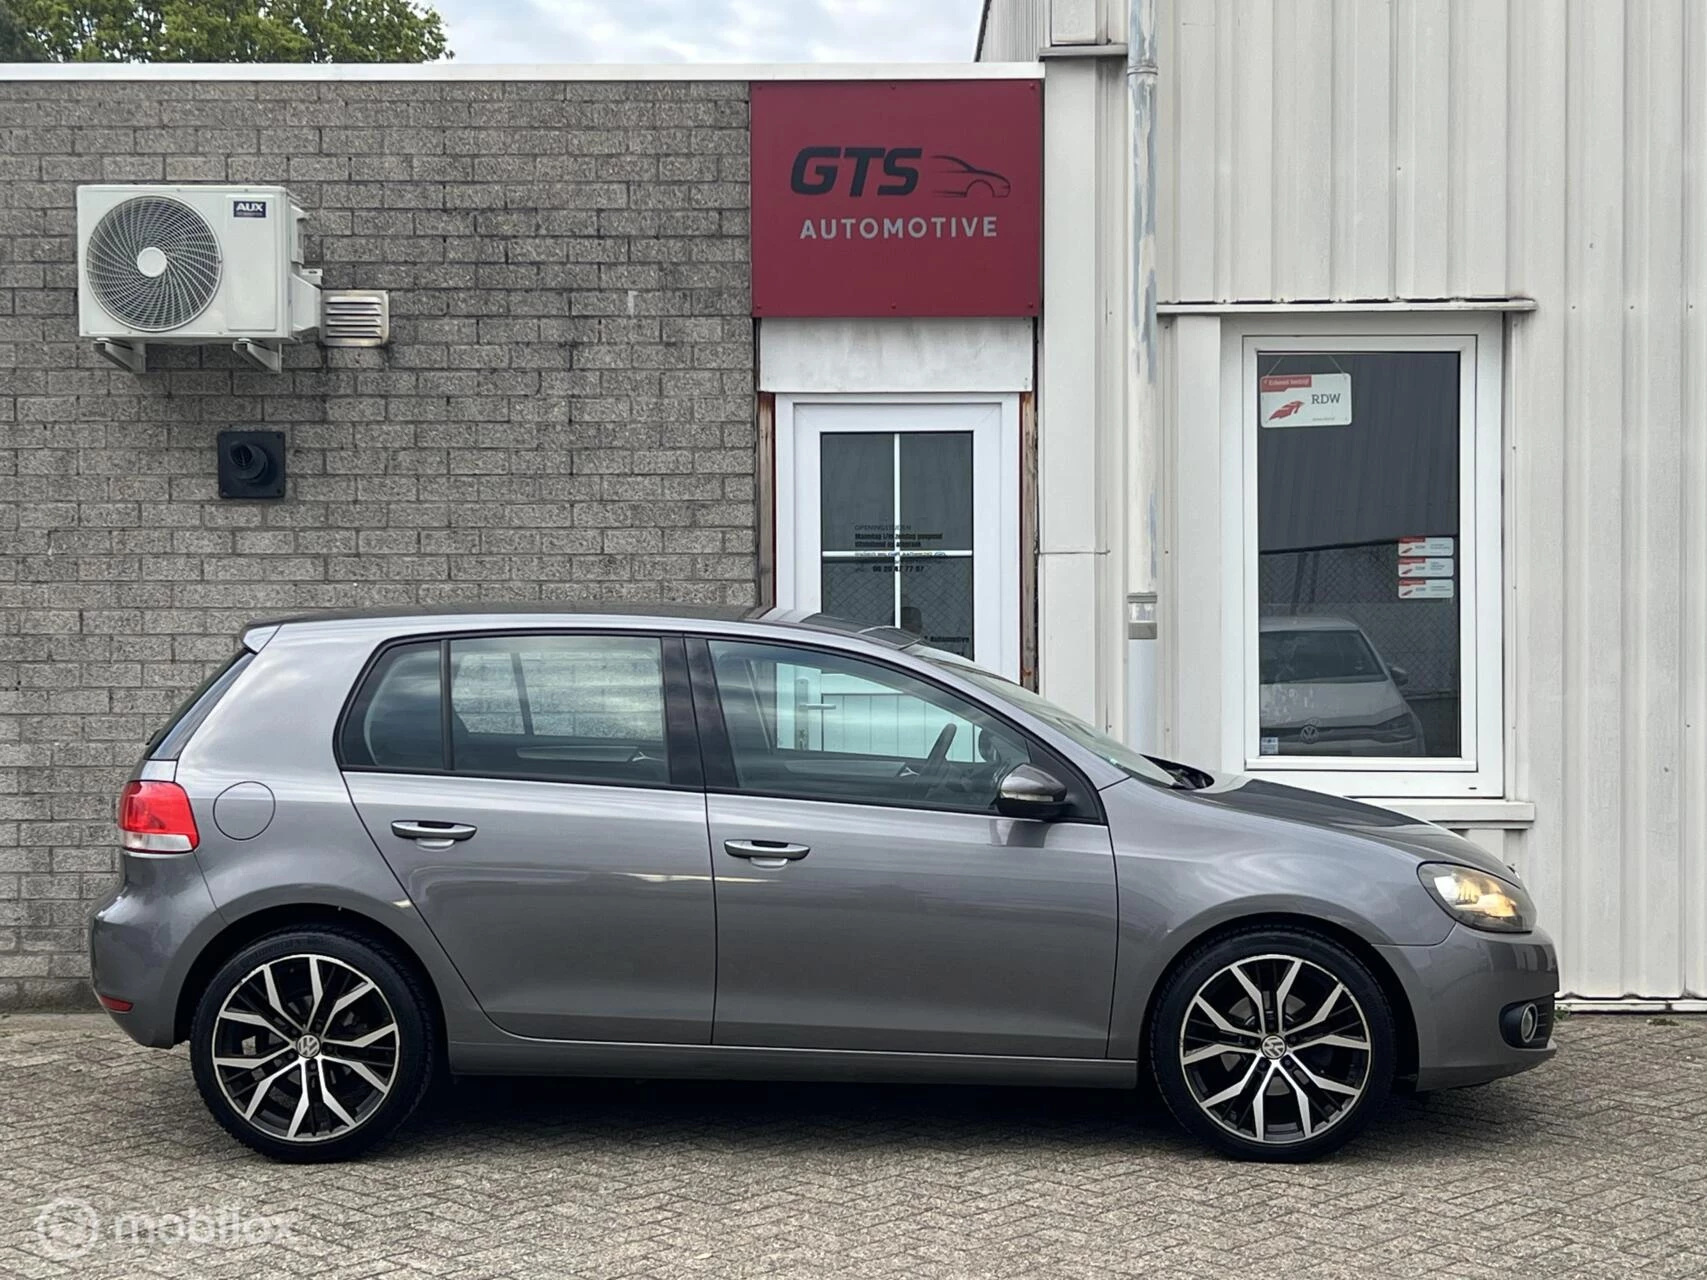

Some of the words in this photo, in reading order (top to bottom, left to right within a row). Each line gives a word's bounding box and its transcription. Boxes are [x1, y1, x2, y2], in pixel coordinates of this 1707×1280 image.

[791, 146, 922, 197] GTS
[236, 202, 264, 211] AUX
[800, 217, 997, 239] AUTOMOTIVE
[1311, 393, 1341, 405] RDW
